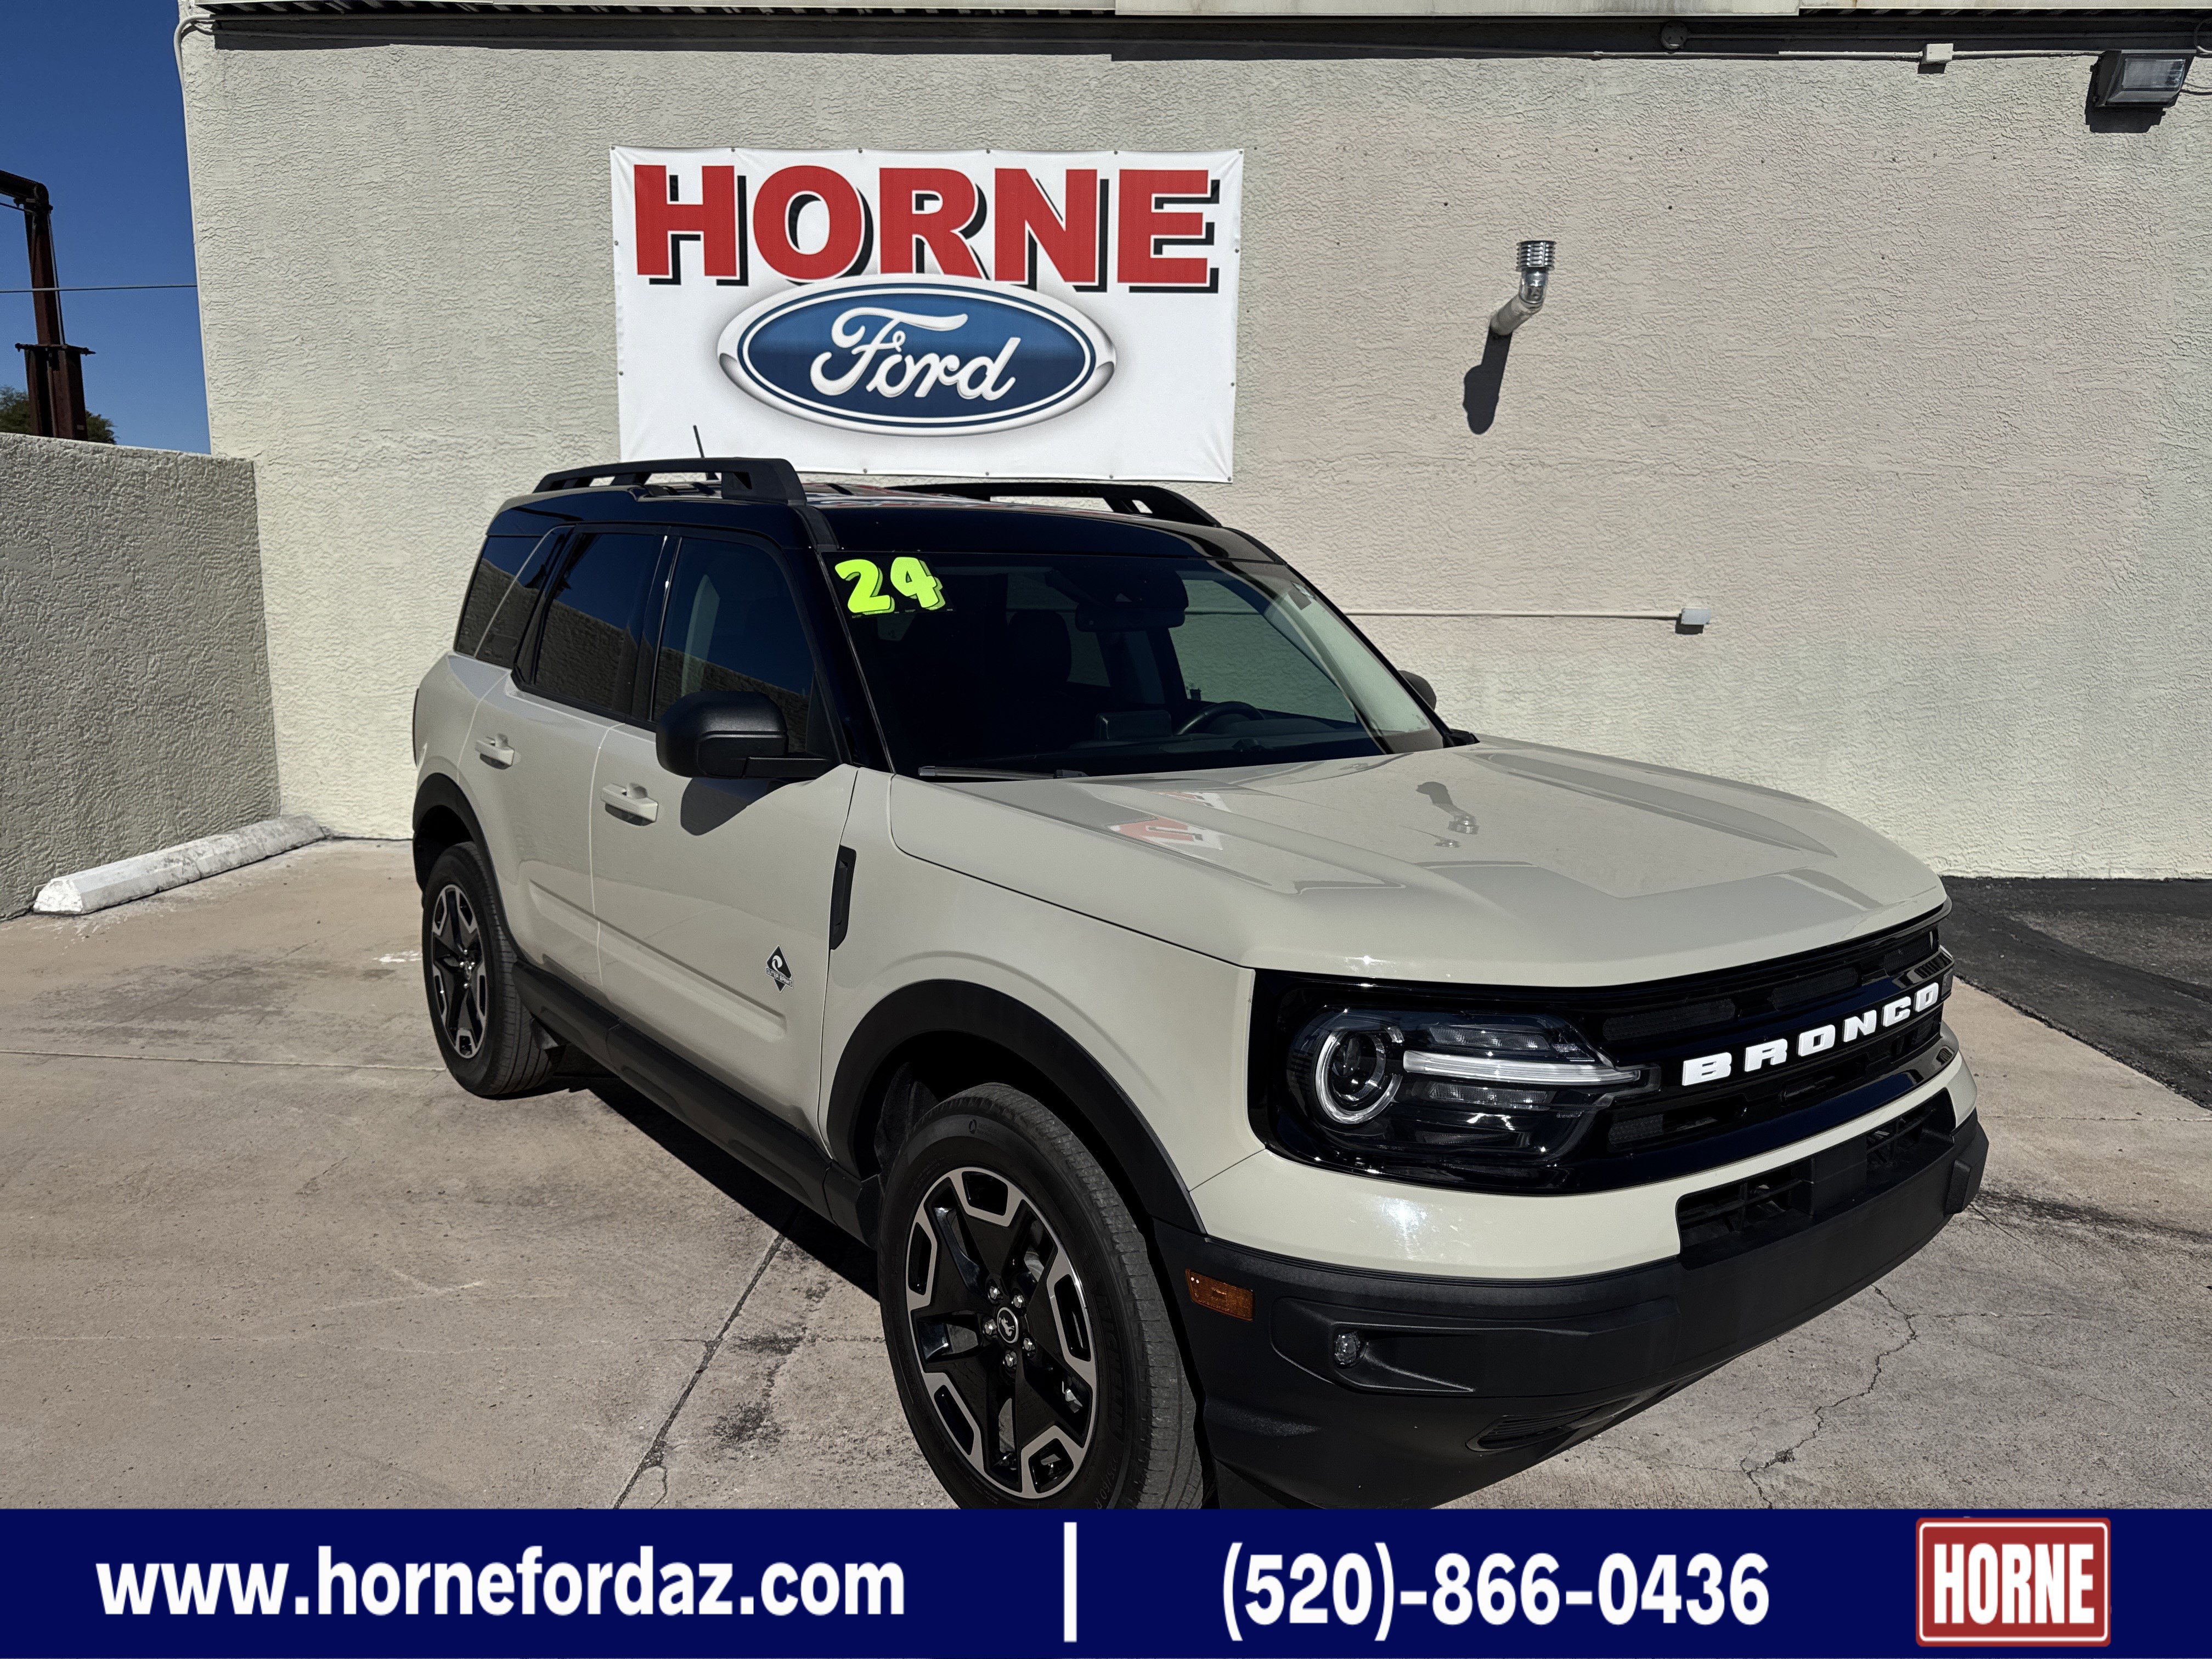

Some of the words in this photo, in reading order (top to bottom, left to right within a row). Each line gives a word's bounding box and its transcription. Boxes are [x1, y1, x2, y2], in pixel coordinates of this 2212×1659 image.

[634, 164, 1210, 286] HORNE
[810, 306, 1022, 401] Ford
[834, 556, 946, 616] 24
[1681, 981, 1940, 1087] BRONCO
